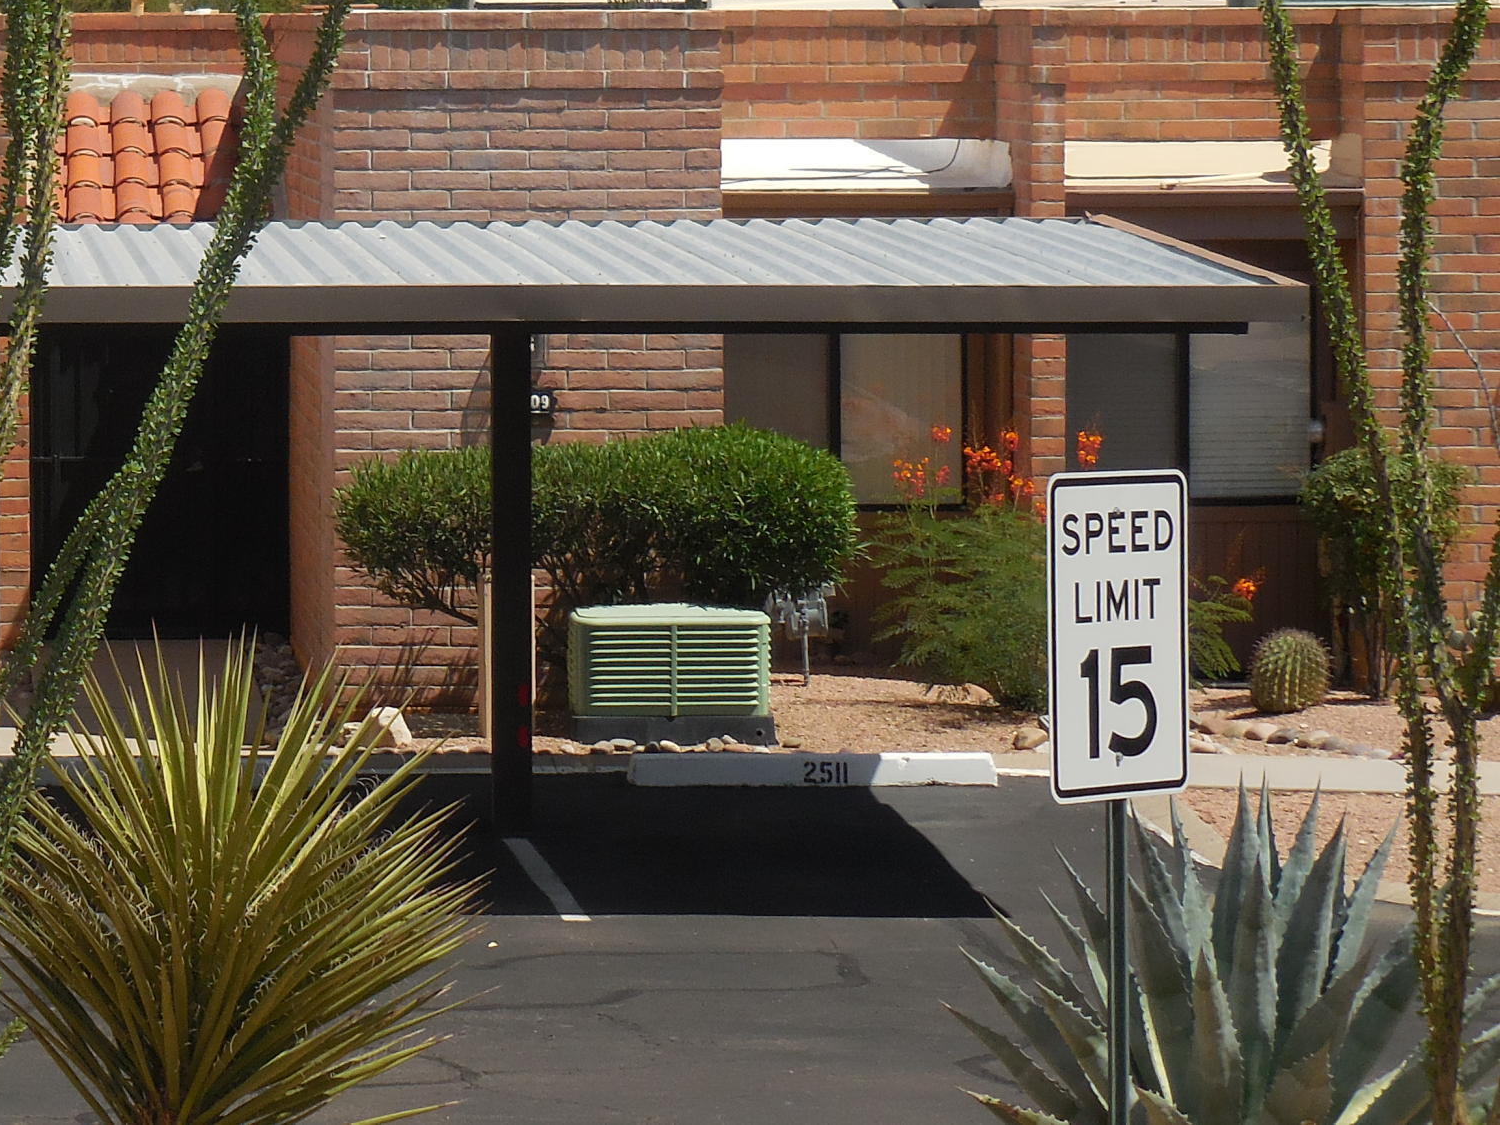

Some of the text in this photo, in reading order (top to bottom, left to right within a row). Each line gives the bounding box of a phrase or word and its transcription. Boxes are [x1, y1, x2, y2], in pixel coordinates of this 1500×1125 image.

[530, 394, 550, 410] 09
[1061, 510, 1174, 556] SPEED
[1074, 578, 1161, 624] LIMIT
[1080, 645, 1158, 760] 15
[803, 761, 849, 784] 2511
